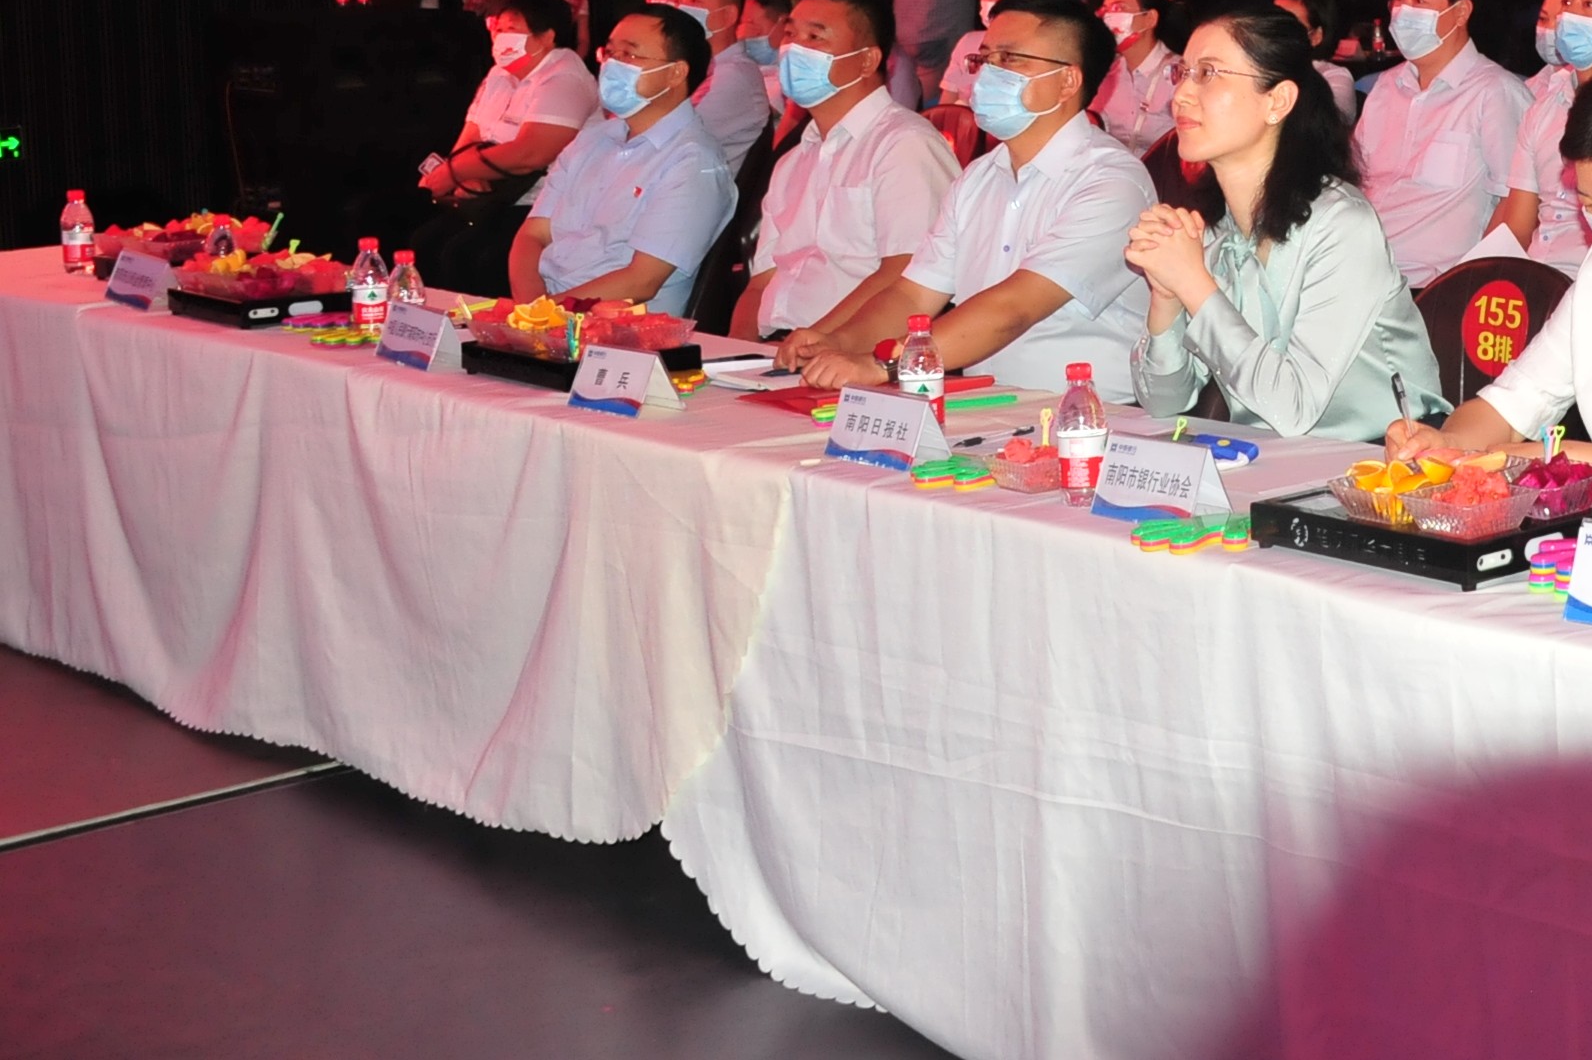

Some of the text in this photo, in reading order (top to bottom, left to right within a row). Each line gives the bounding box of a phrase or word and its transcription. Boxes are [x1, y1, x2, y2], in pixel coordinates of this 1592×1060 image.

[1475, 295, 1523, 329] 155
[1476, 331, 1513, 364] 8排
[844, 413, 908, 441] 南阳日报社
[1105, 462, 1192, 499] 南阳市银行业协会
